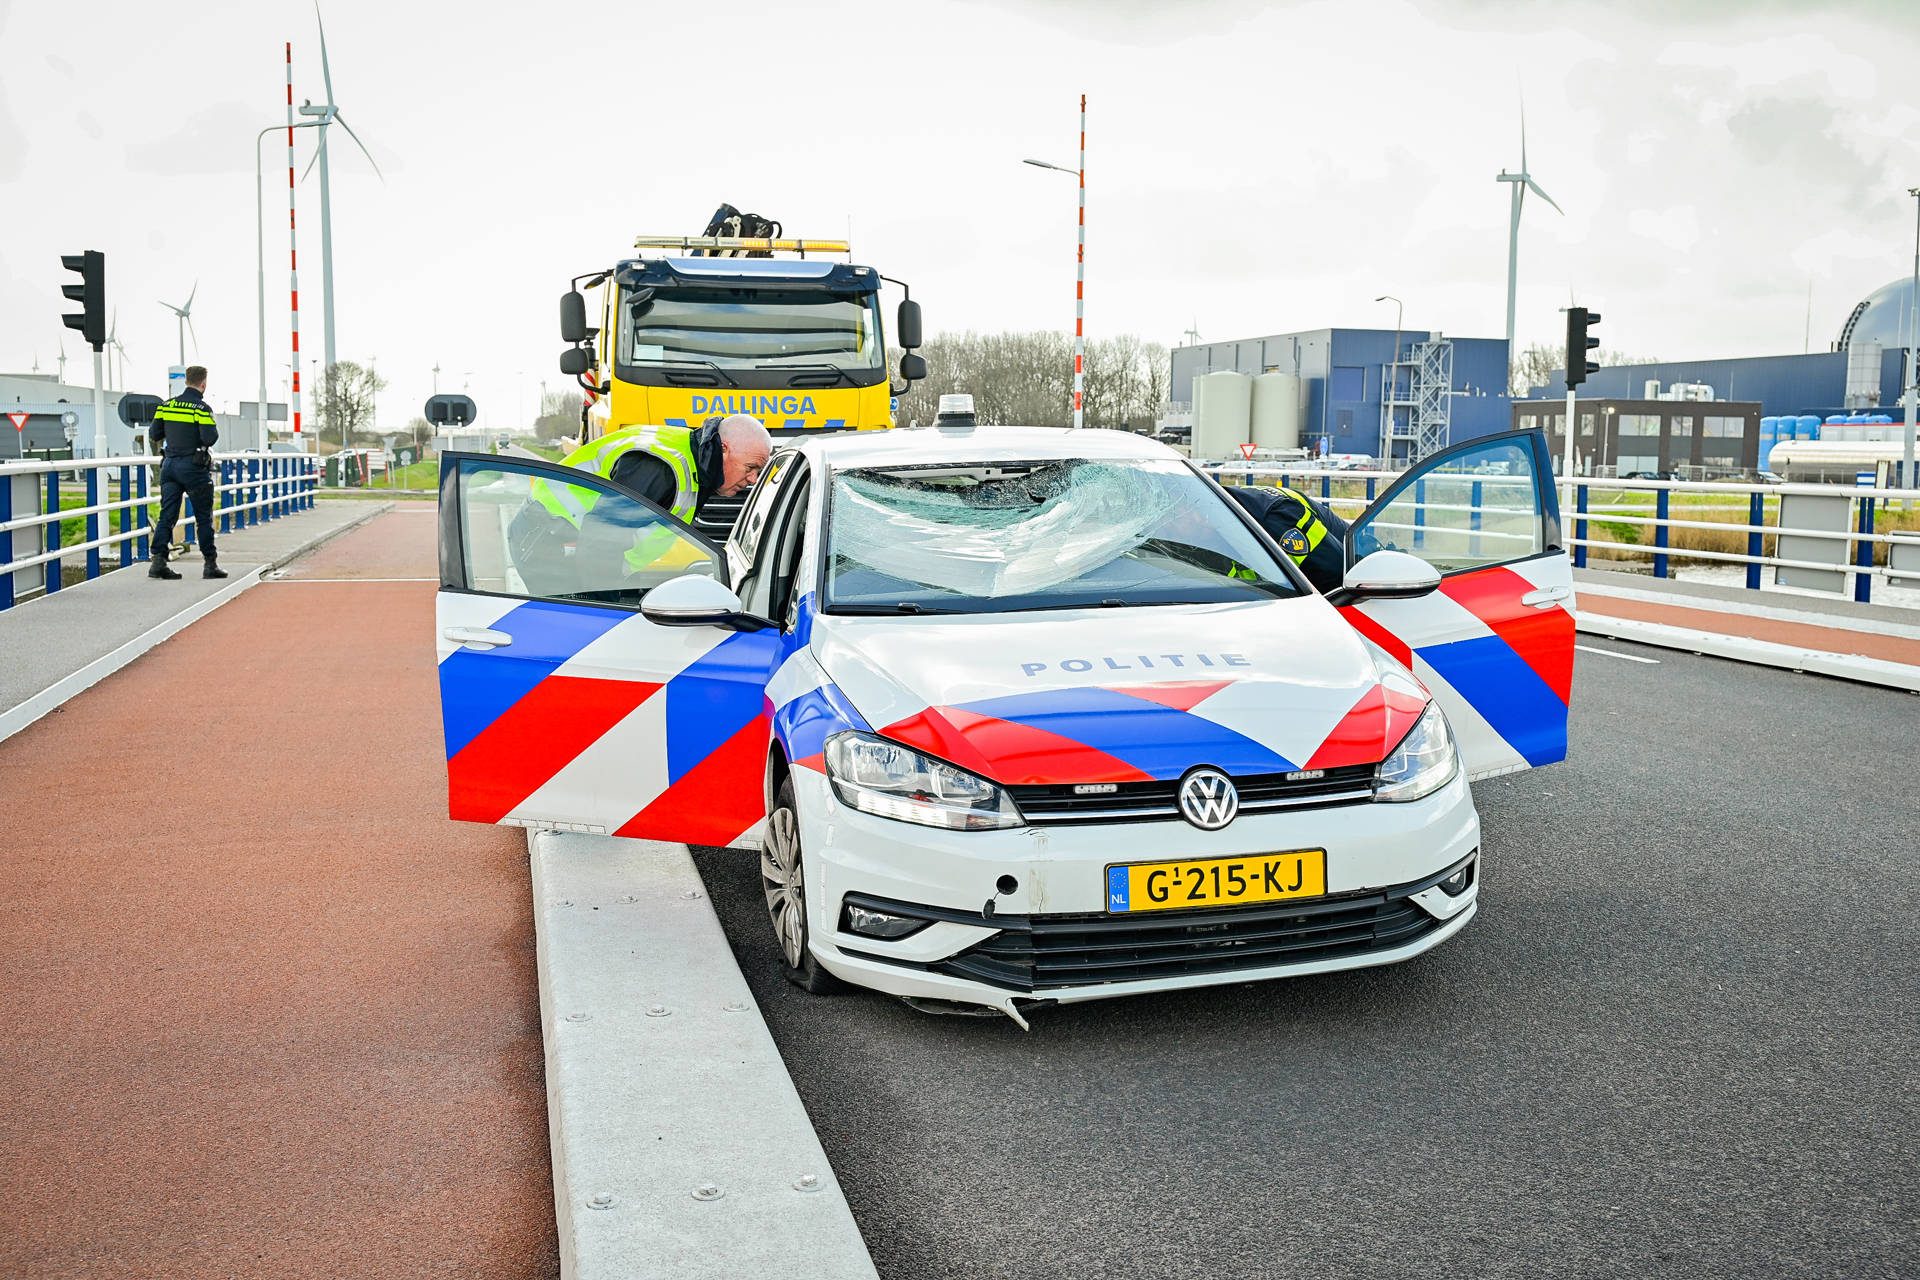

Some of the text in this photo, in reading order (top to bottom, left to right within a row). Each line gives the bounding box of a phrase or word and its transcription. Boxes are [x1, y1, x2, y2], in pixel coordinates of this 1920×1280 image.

[692, 395, 816, 415] DALLINGA
[1020, 653, 1251, 677] POLITIE
[1111, 893, 1127, 905] NL
